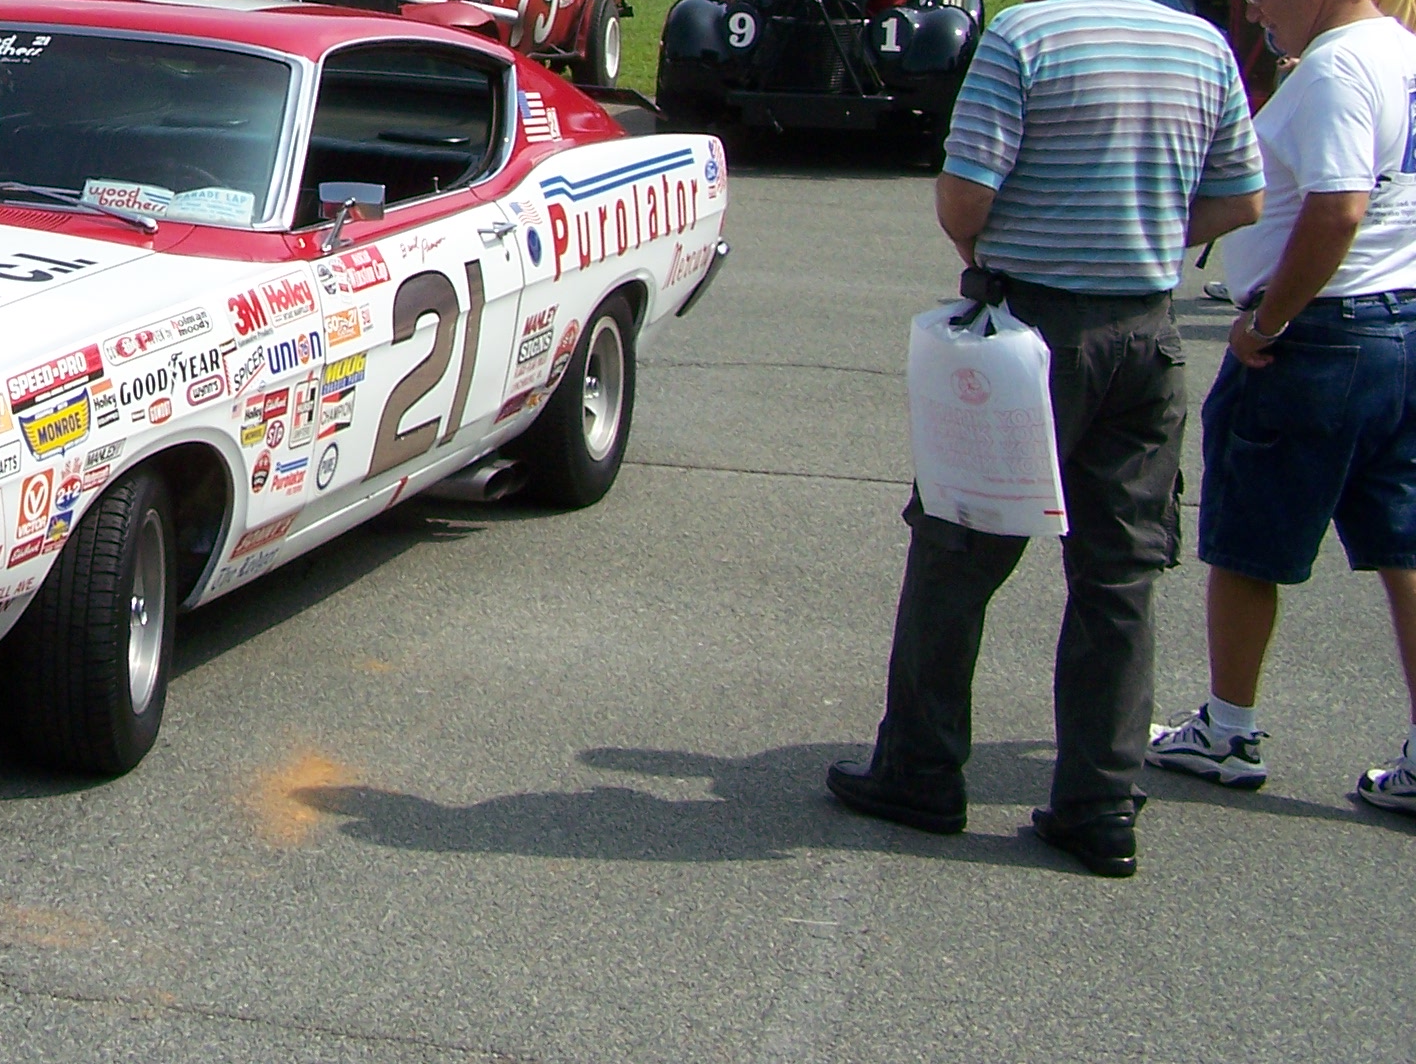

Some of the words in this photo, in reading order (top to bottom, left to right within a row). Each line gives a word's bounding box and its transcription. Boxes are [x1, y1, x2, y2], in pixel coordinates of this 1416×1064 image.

[32, 36, 52, 46] 21
[728, 12, 756, 47] 9
[880, 17, 902, 52] 1
[226, 193, 247, 204] LAP
[546, 173, 699, 283] Purolator
[372, 259, 390, 281] Cup
[261, 278, 316, 315] Holley
[227, 288, 268, 336] 3M
[178, 319, 210, 337] moody
[234, 344, 265, 392] SPICER
[325, 352, 367, 385] MOOG
[360, 258, 487, 484] 21
[93, 393, 117, 412] Holley
[36, 411, 83, 447] MONROE
[268, 422, 283, 447] STP
[56, 481, 81, 504] 2+2
[17, 515, 47, 538] VICTOR
[15, 576, 36, 593] AVE
